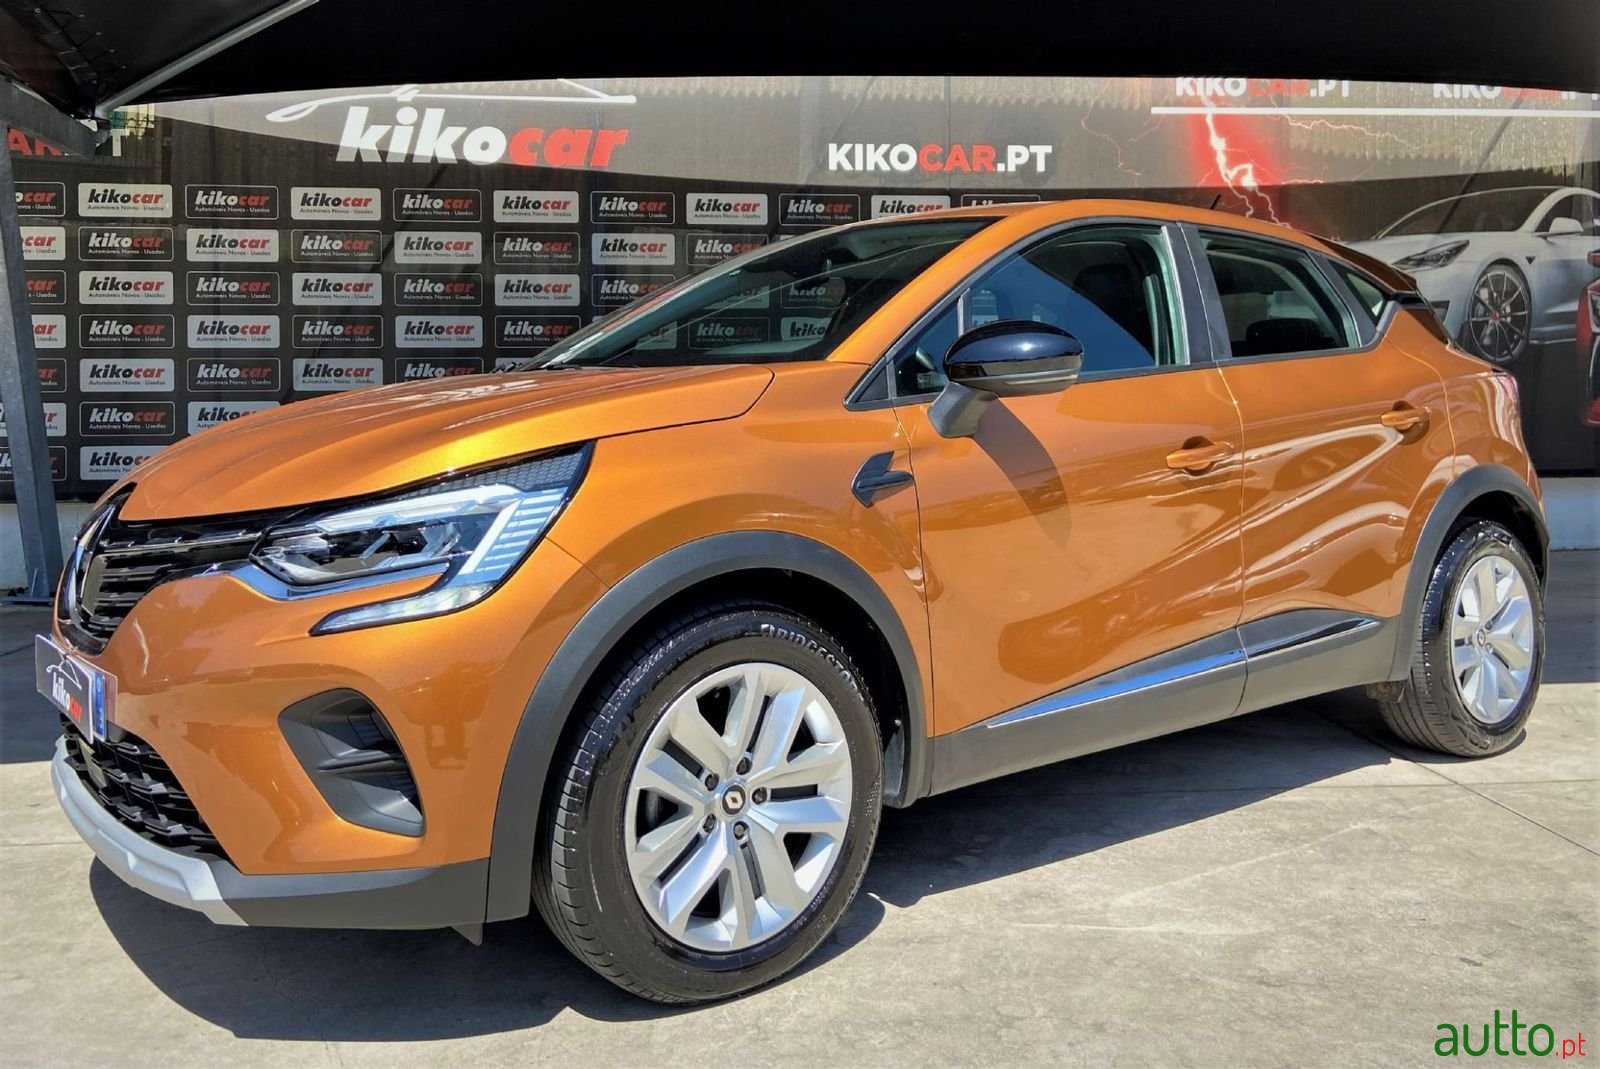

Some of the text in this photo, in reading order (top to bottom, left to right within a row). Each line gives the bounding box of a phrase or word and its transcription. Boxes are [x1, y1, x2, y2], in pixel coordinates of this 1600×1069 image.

[336, 106, 628, 168] kikocar
[828, 143, 1053, 172] KIKOCAR.PT
[88, 189, 163, 203] kikocar
[195, 190, 269, 205] kikocar
[301, 193, 372, 206] kikocar
[402, 194, 472, 208] kikocar
[502, 196, 571, 209] kikocar
[600, 197, 666, 211] kikocar
[694, 198, 760, 211] kikocar
[788, 200, 852, 213] kikocar
[88, 233, 164, 247] kikocar
[196, 234, 269, 248] kikocar
[301, 236, 373, 249] kikocar
[403, 237, 473, 250] kikocar
[502, 238, 572, 251] kikocar
[601, 239, 667, 252] kikocar
[89, 277, 164, 290] kikocar
[196, 278, 270, 291] kikocar
[302, 278, 373, 291] kikocar
[404, 279, 474, 292] kikocar
[504, 280, 572, 293] kikocar
[90, 320, 165, 335] kikocar
[197, 321, 271, 335] kikocar
[302, 321, 374, 335] kikocar
[404, 322, 474, 335] kikocar
[504, 321, 572, 336] kikocar
[790, 322, 826, 338] kiko
[90, 364, 165, 378] kikocar
[197, 364, 271, 378] kikocar
[302, 364, 374, 377] kikocar
[90, 408, 166, 422] kikocar
